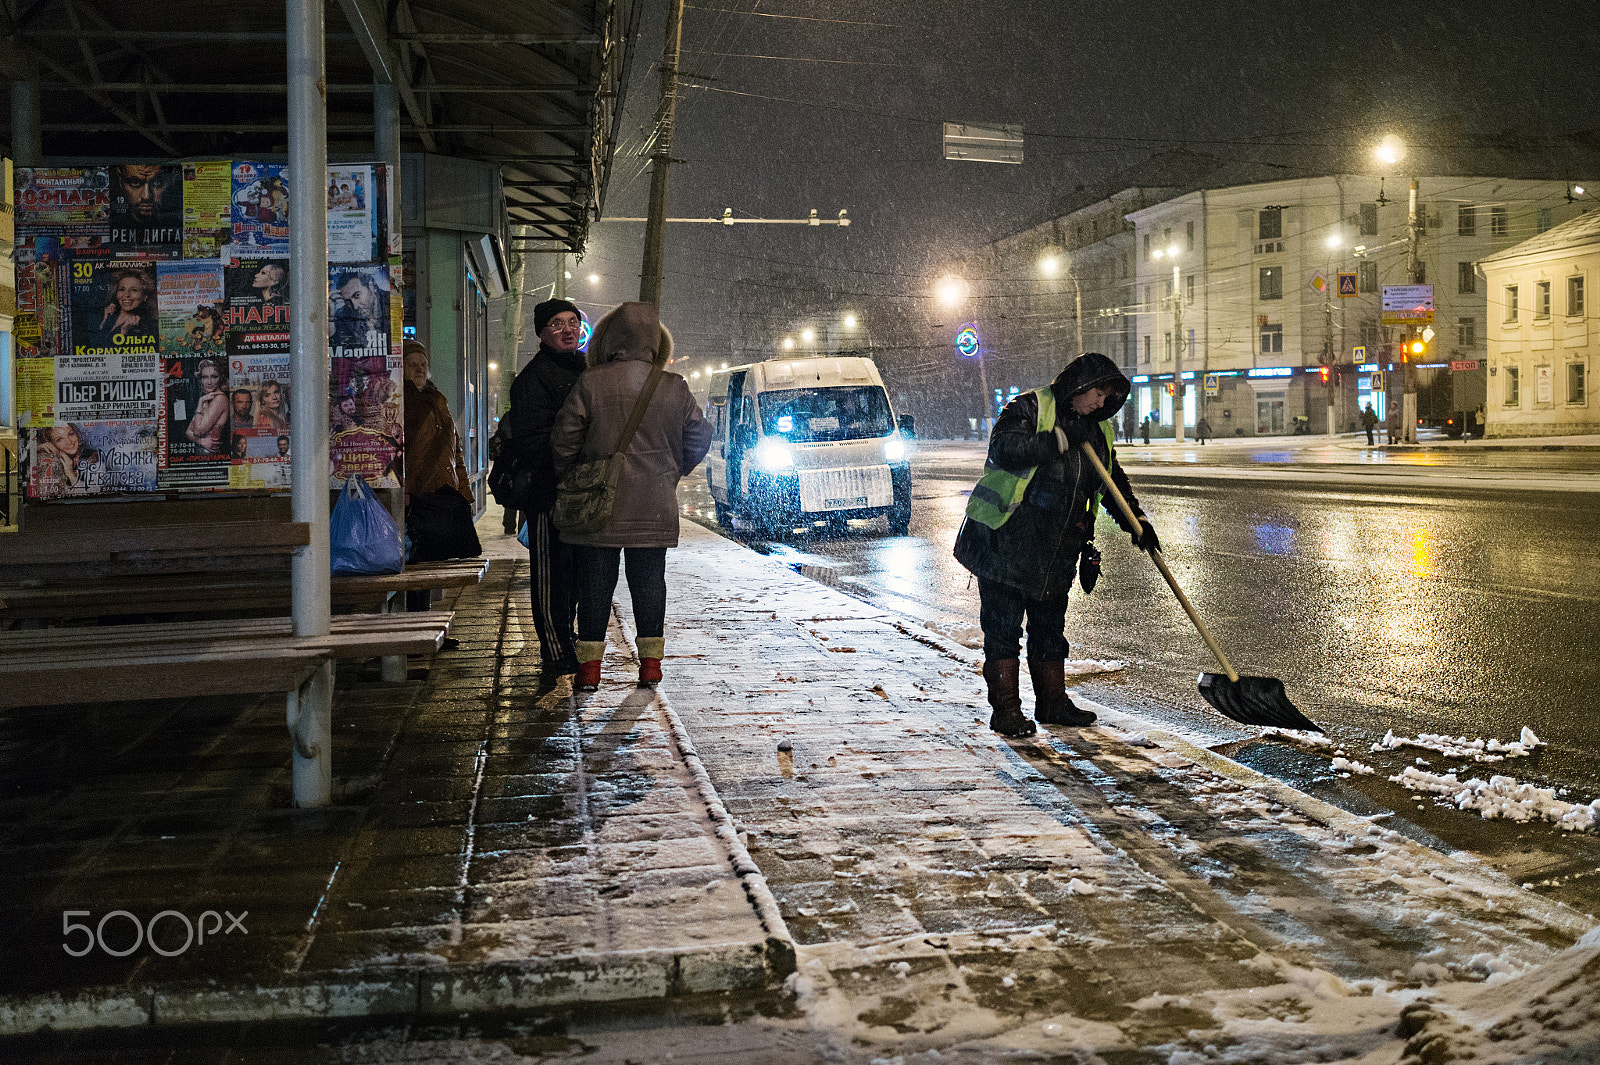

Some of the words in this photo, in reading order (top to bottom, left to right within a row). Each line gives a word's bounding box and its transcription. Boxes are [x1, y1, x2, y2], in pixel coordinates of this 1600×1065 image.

[196, 166, 205, 175] 6
[112, 228, 137, 243] РЕМ
[142, 228, 181, 244] ДИГГА
[73, 262, 93, 278] 30
[129, 355, 155, 363] ФЕВРАЛЯ
[169, 361, 184, 378] 4
[232, 360, 243, 373] 9
[1455, 362, 1476, 370] СТОП
[262, 371, 278, 380] НО
[100, 380, 155, 401] РИШАР
[112, 402, 139, 410] РИЧАРД
[88, 447, 154, 473] Марина
[343, 453, 378, 462] ЦИРК
